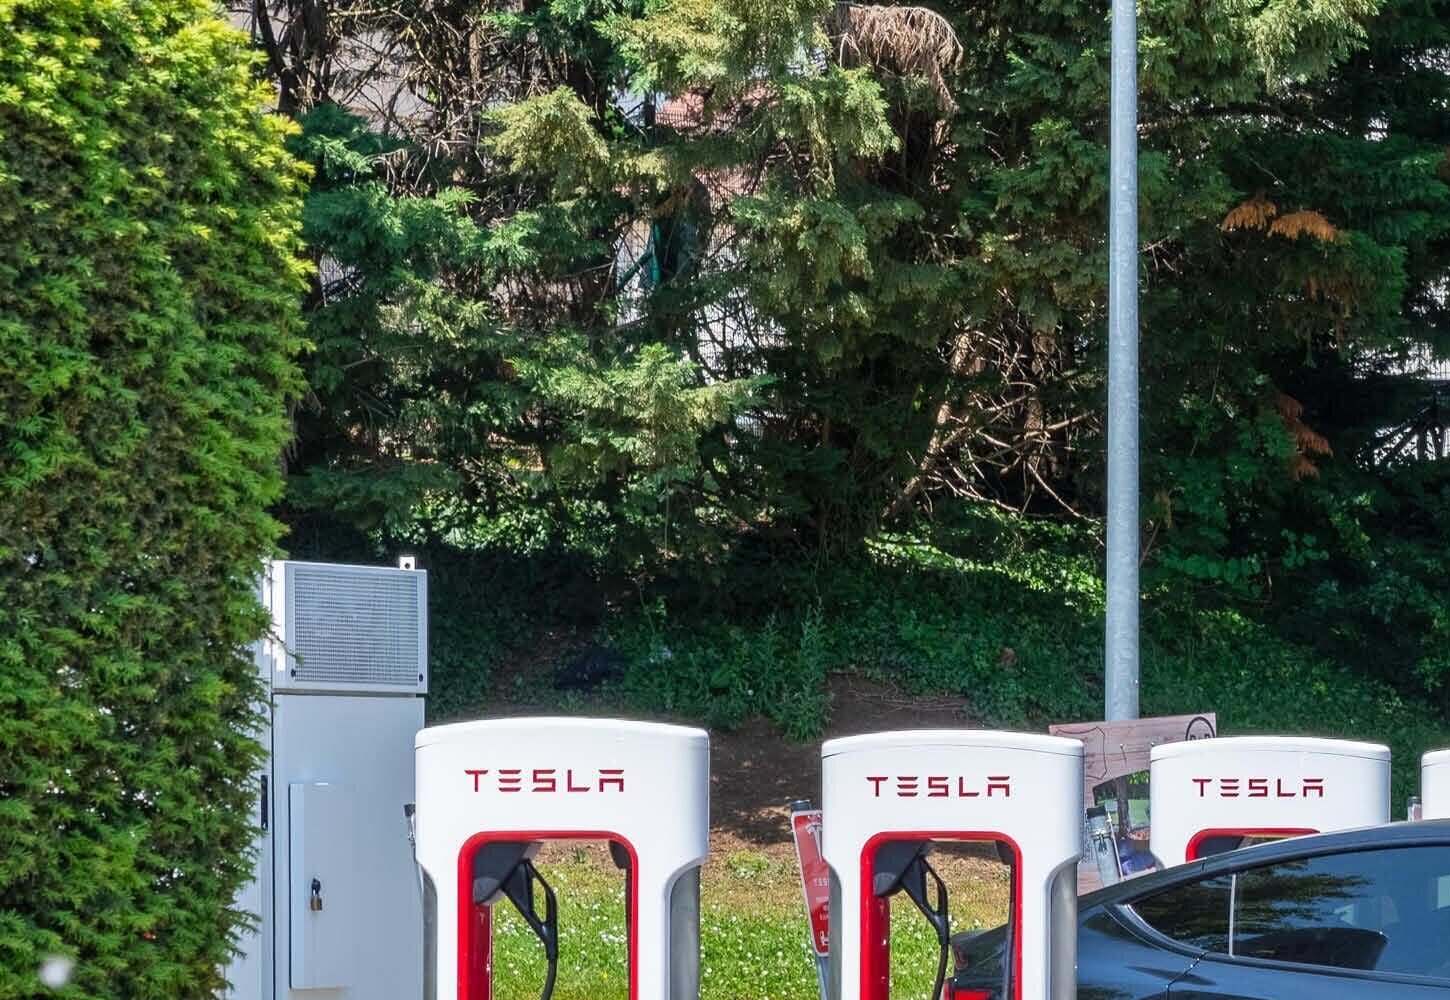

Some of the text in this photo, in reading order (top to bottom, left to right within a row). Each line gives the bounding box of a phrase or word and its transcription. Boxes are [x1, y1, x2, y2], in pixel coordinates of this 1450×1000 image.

[464, 770, 624, 792] TESLA
[867, 776, 1010, 797] TESLA
[1192, 779, 1323, 797] TESLA
